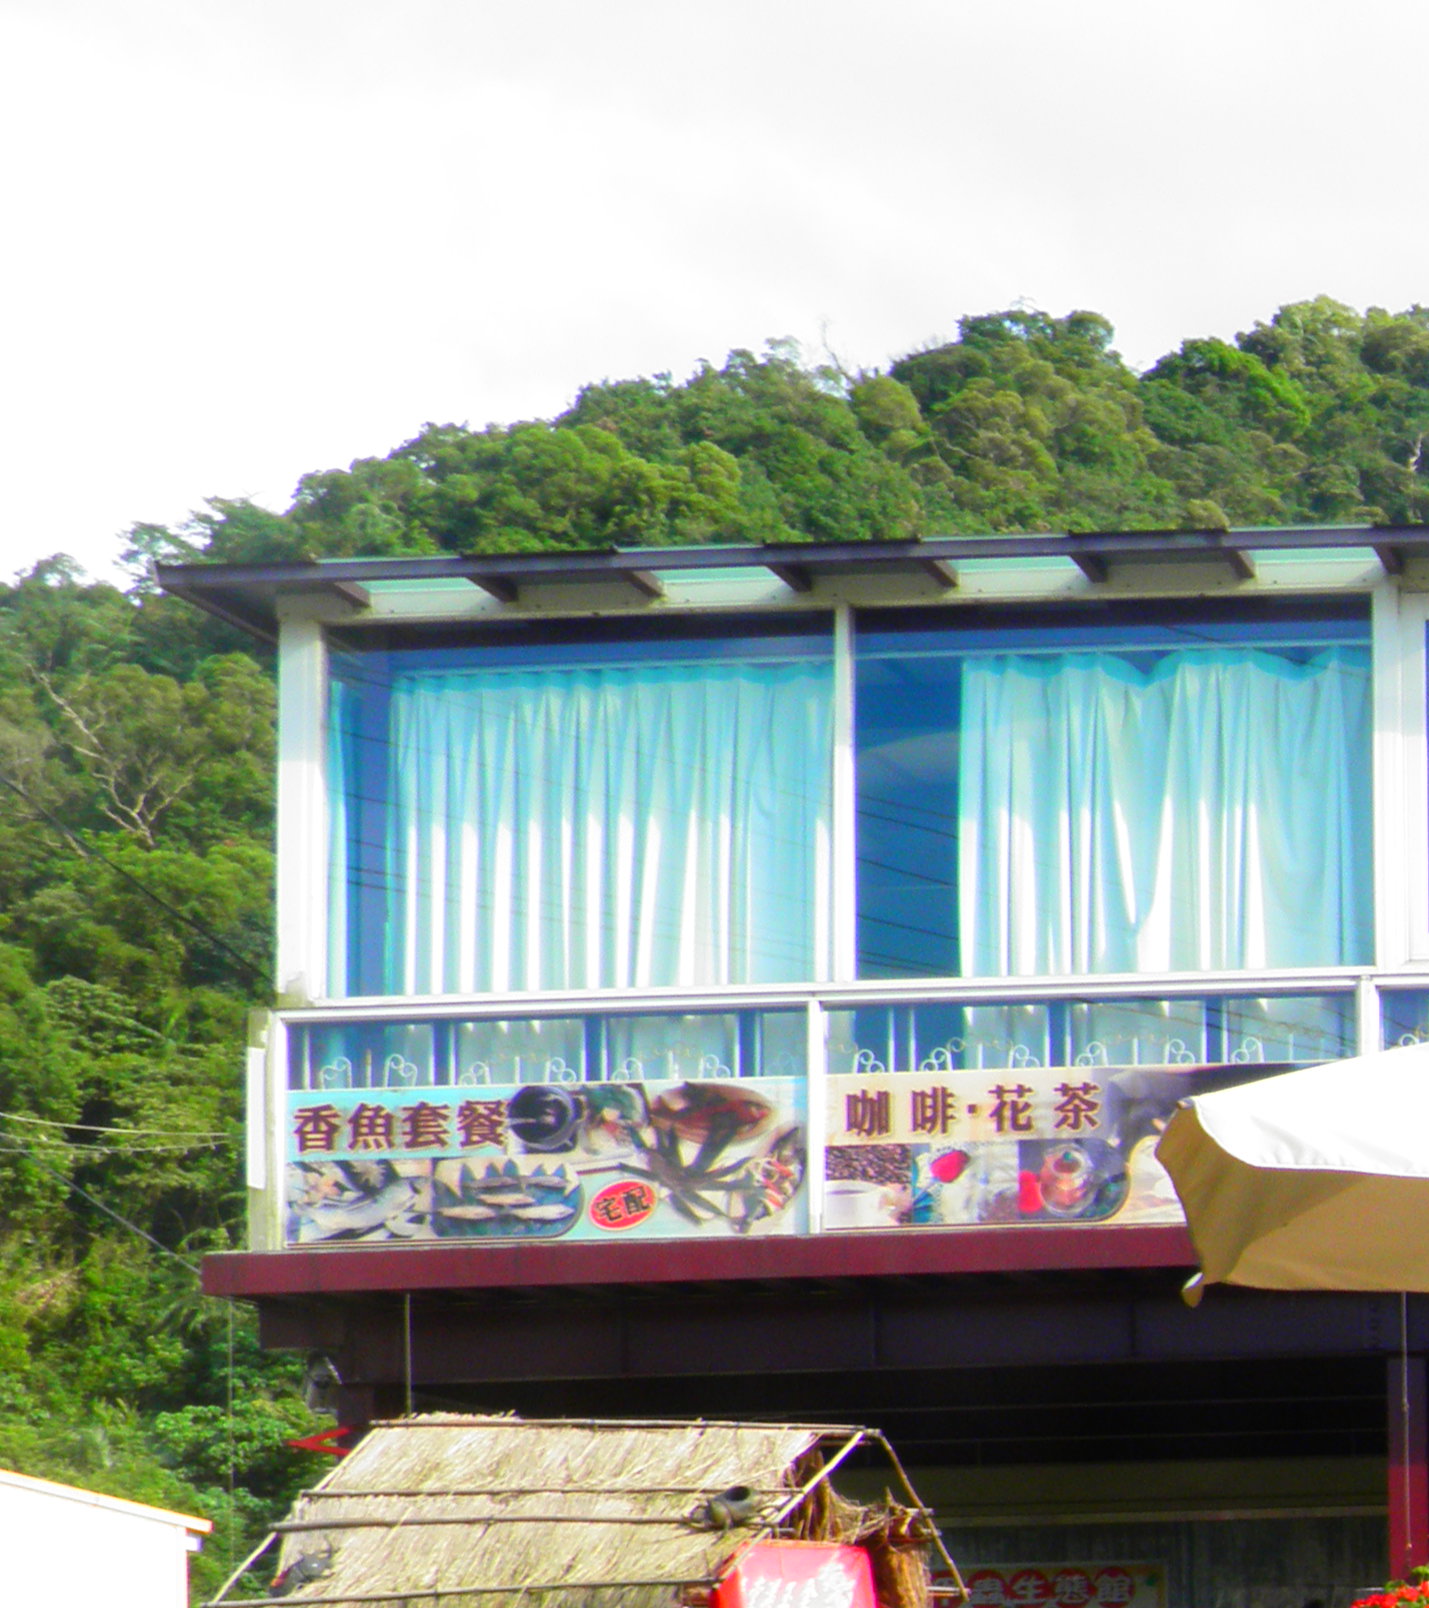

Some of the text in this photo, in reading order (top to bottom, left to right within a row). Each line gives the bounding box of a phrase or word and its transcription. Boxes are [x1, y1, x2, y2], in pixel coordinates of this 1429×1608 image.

[293, 1099, 508, 1153] 香魚套餐
[595, 1187, 651, 1224] 宅配
